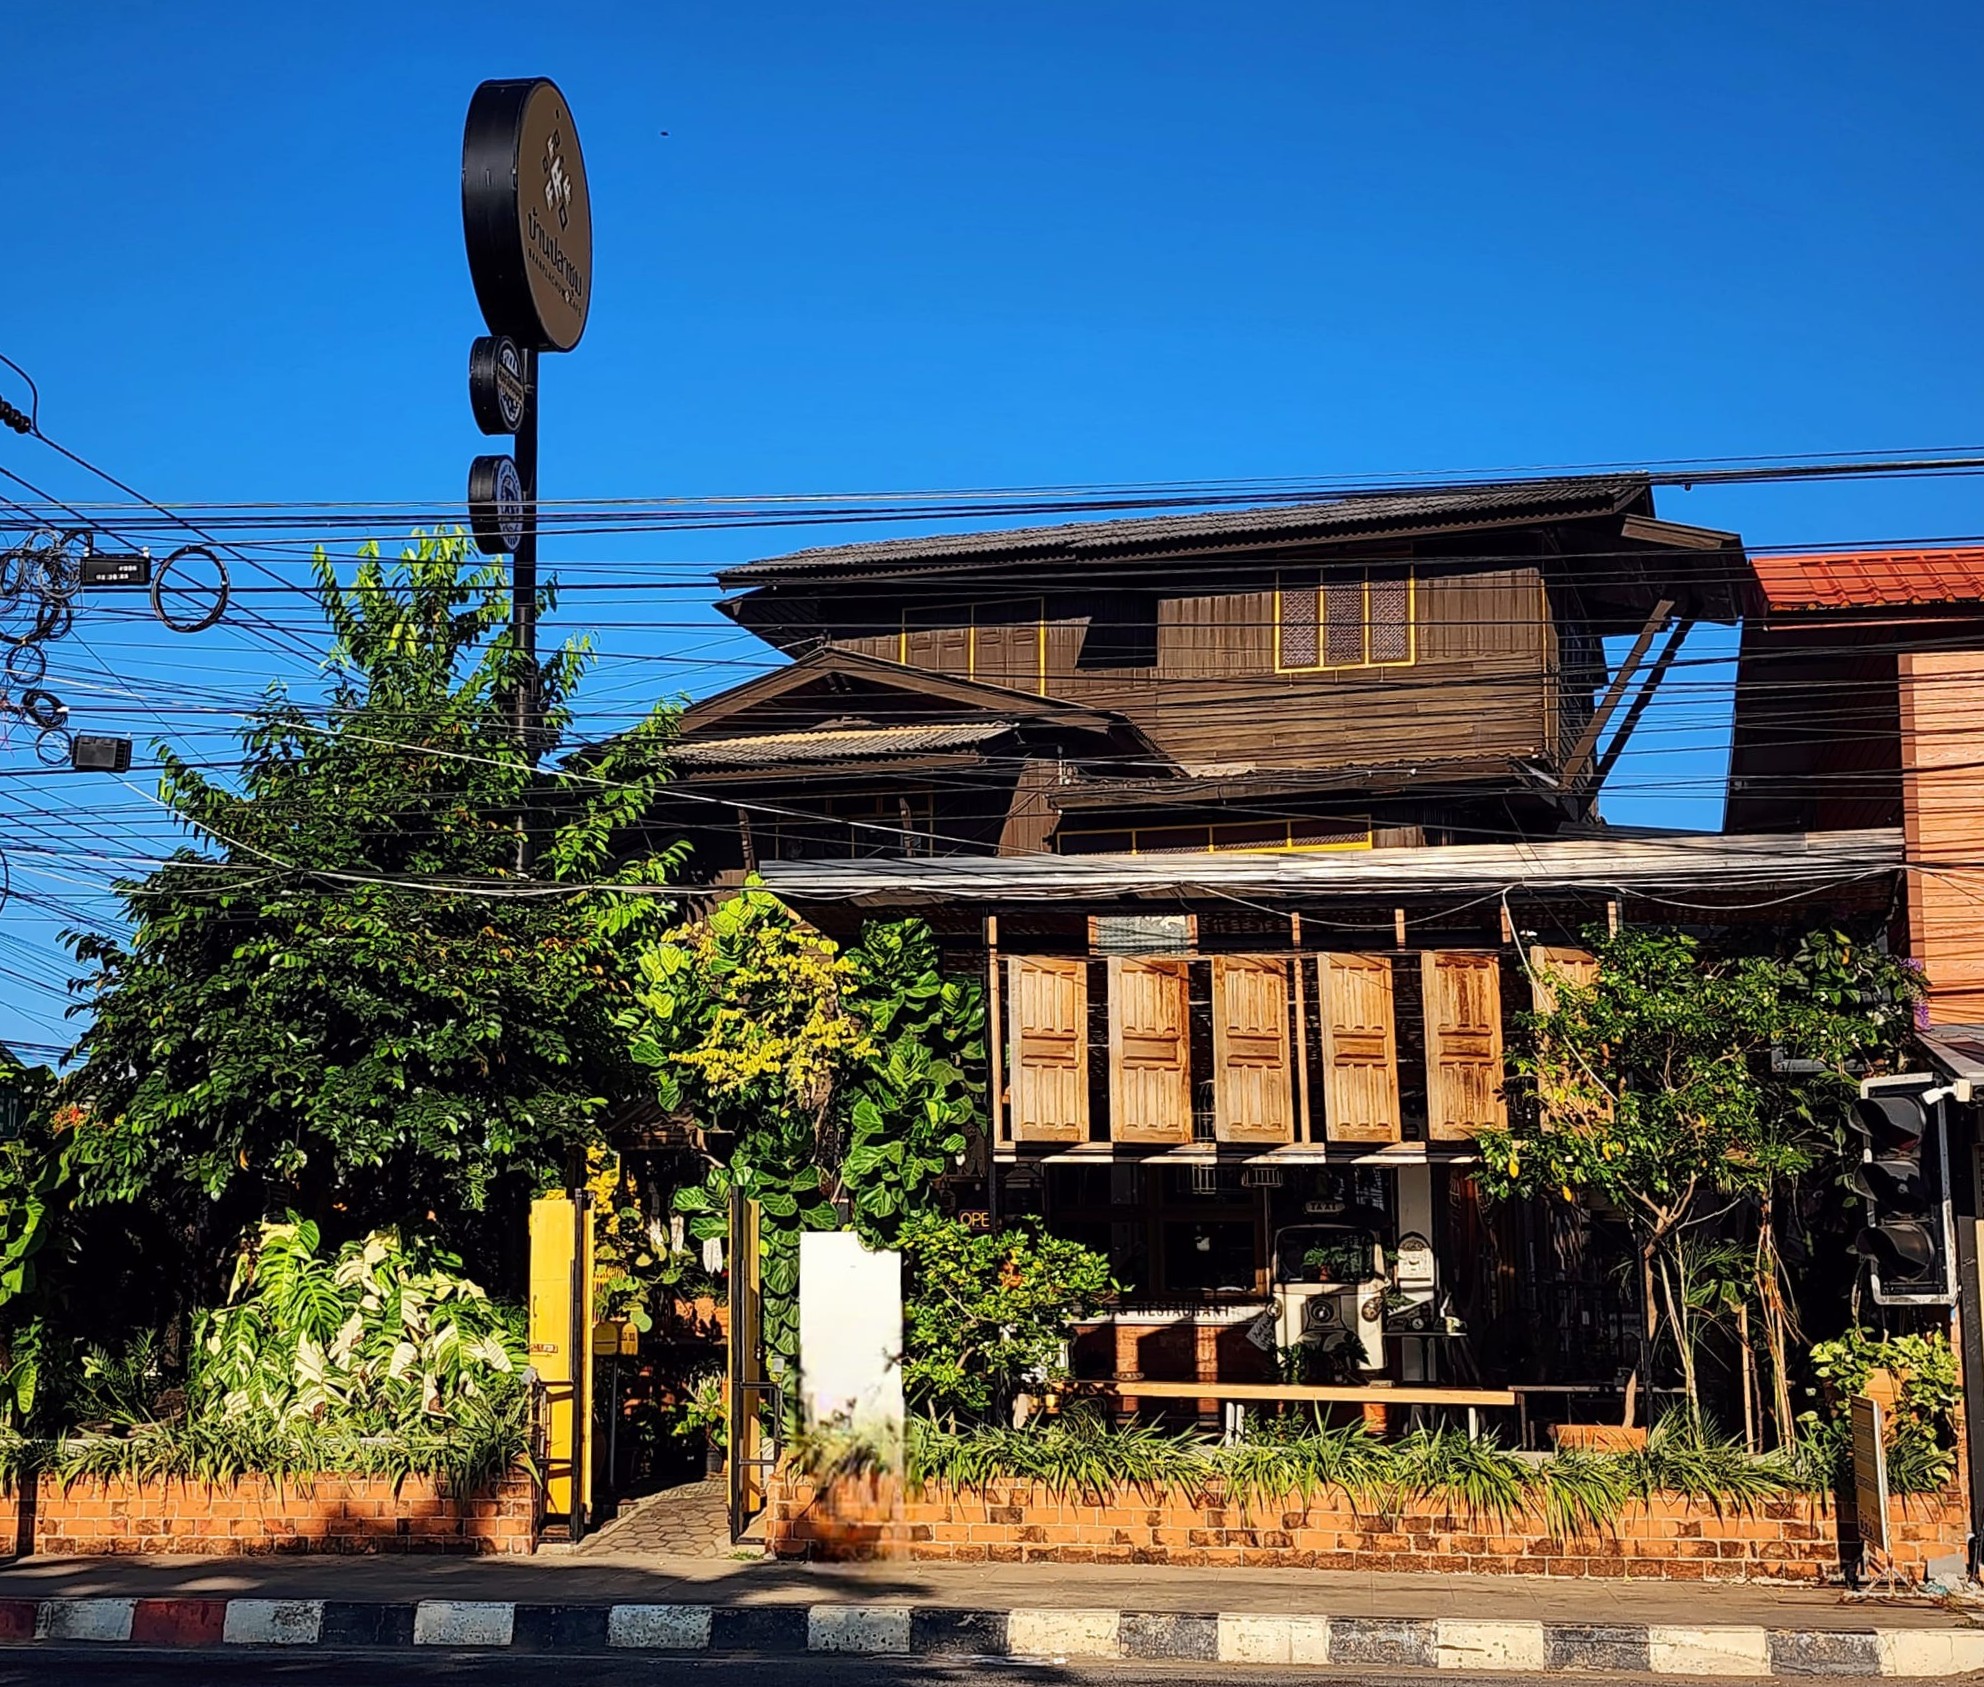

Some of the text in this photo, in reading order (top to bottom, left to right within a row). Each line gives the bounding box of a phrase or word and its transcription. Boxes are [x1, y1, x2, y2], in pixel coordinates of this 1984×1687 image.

[1310, 1202, 1336, 1211] TAXI
[960, 1212, 1000, 1228] OPE
[1137, 1302, 1230, 1317] RESTAURANT
